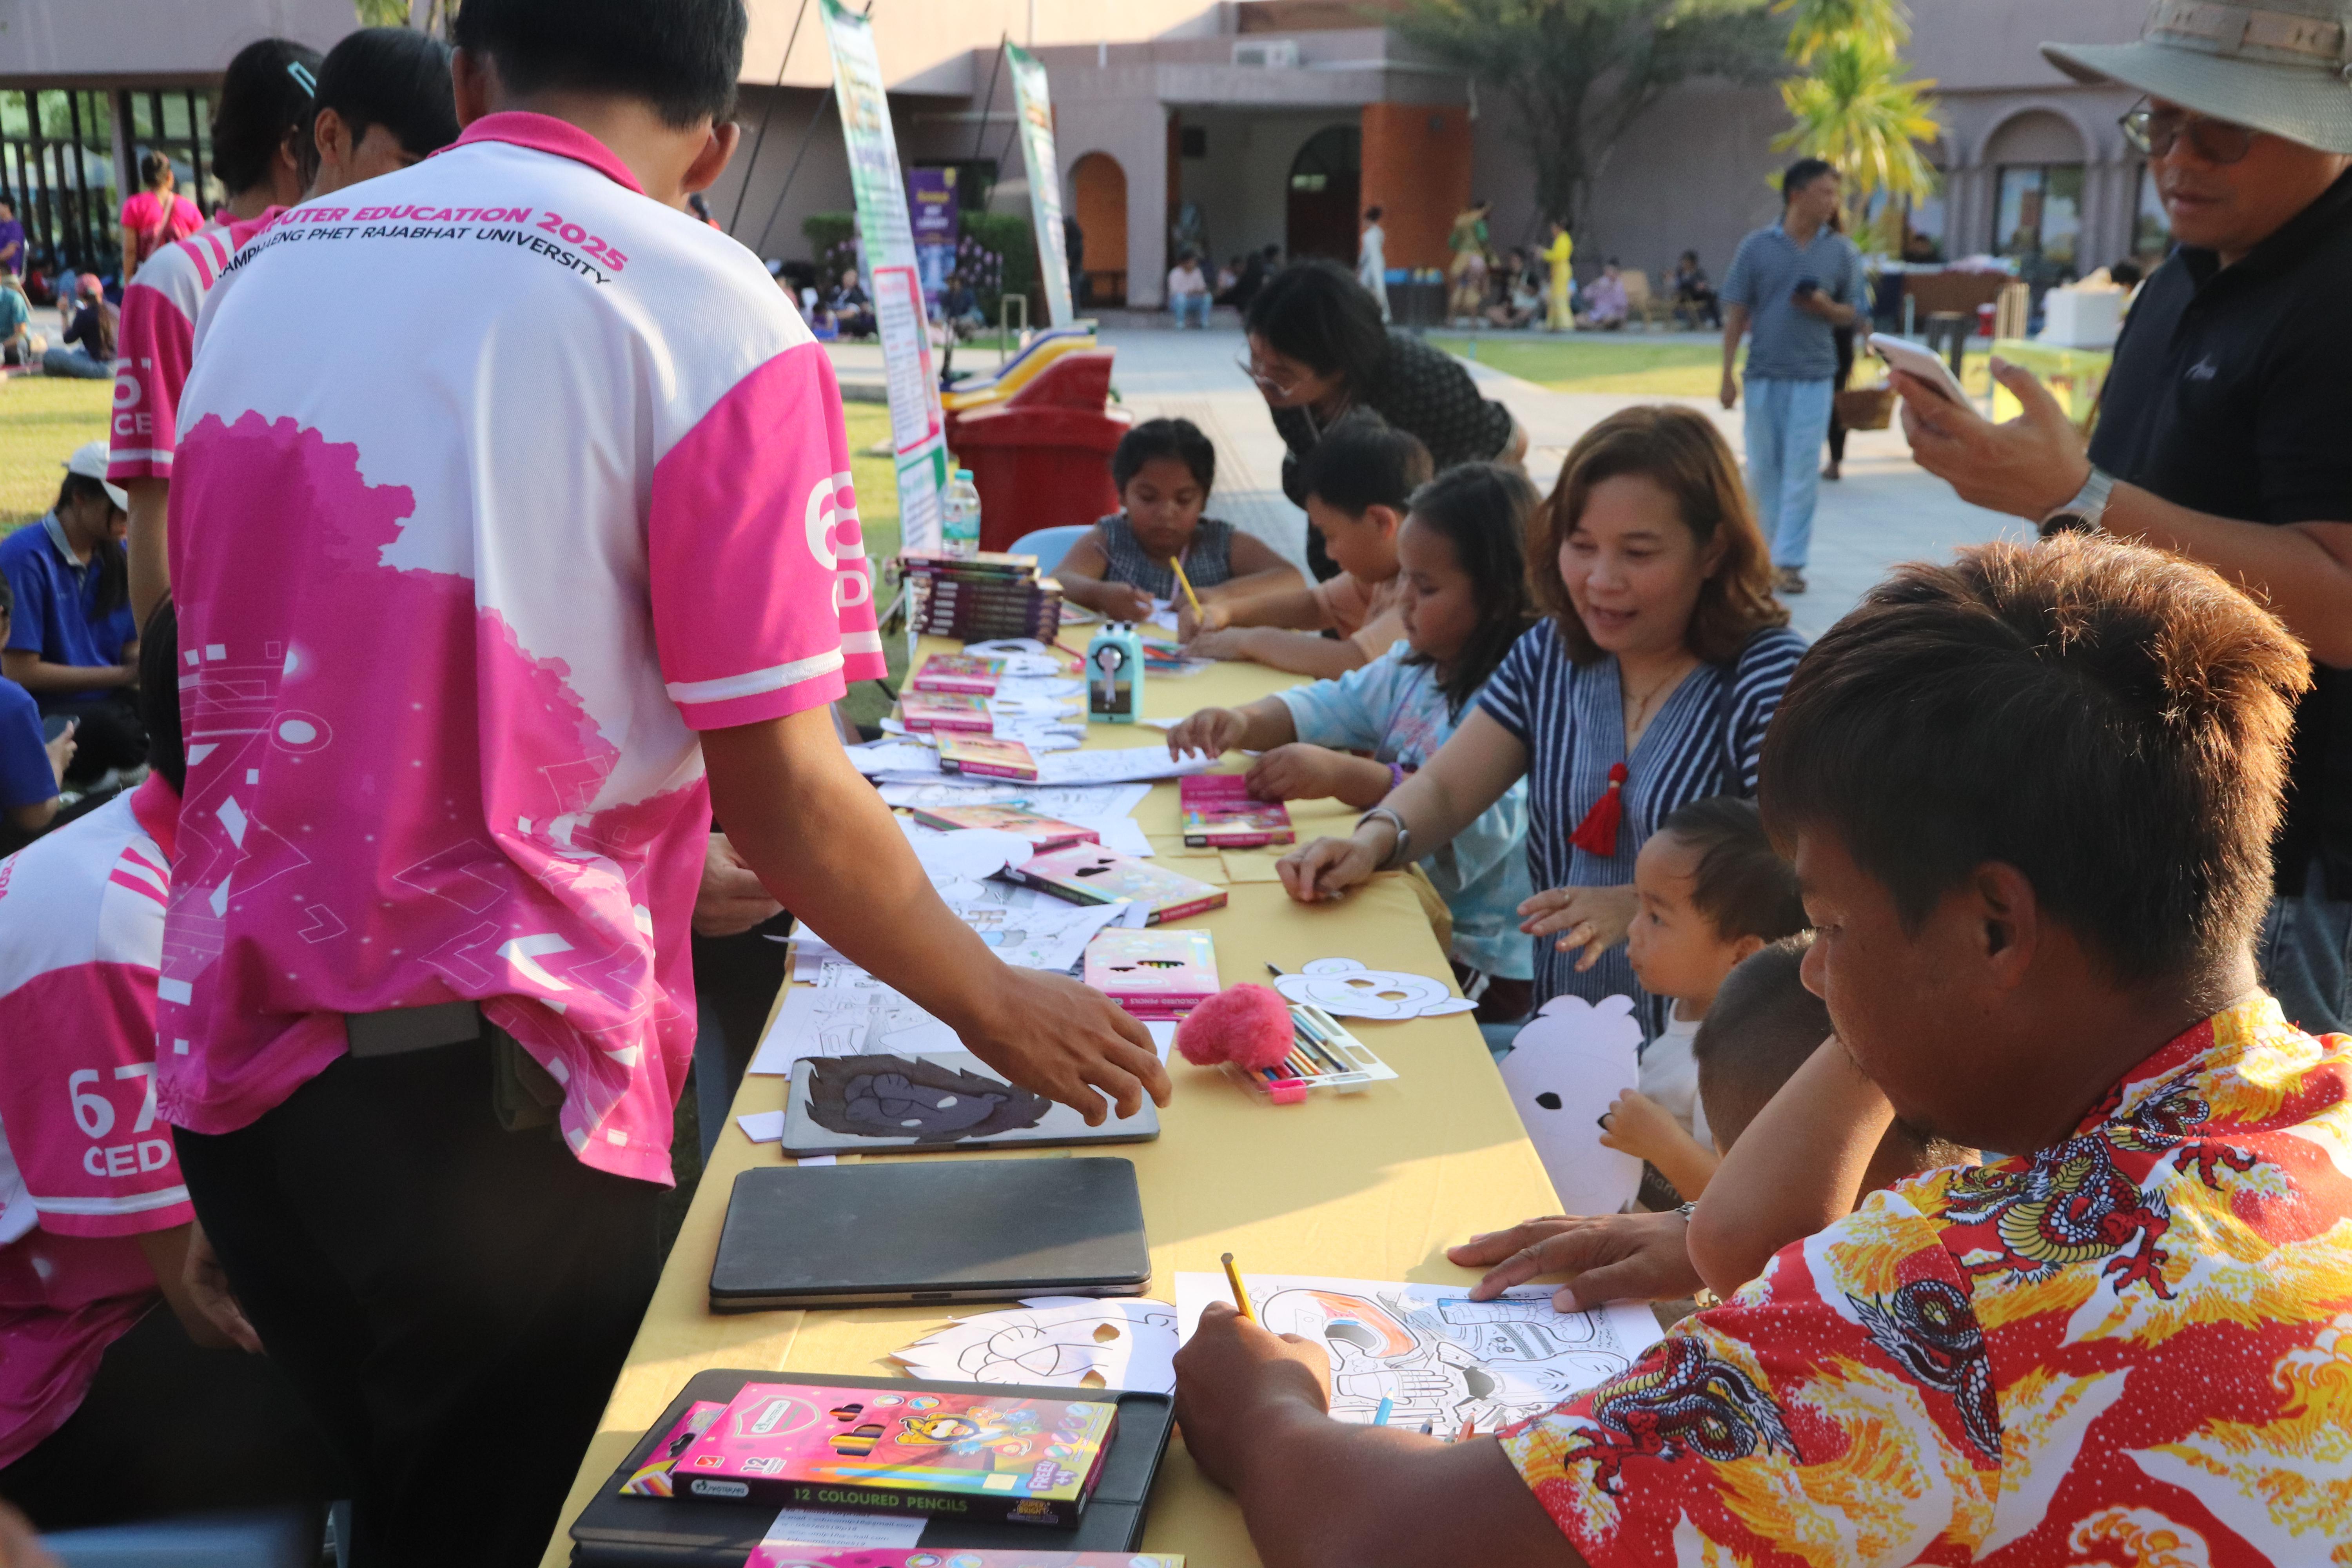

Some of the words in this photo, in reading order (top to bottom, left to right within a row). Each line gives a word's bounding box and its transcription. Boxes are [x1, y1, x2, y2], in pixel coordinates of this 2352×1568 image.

[307, 228, 359, 240] PHET
[361, 226, 472, 239] RAJABHAT
[475, 228, 611, 285] UNIVERSITY
[353, 205, 534, 223] EDUCATION
[537, 211, 628, 272] 2025
[69, 1062, 156, 1139] 67
[83, 1139, 171, 1178] CED
[794, 1488, 810, 1500] 12
[818, 1490, 899, 1506] COLOURED
[907, 1497, 968, 1512] PENCILS
